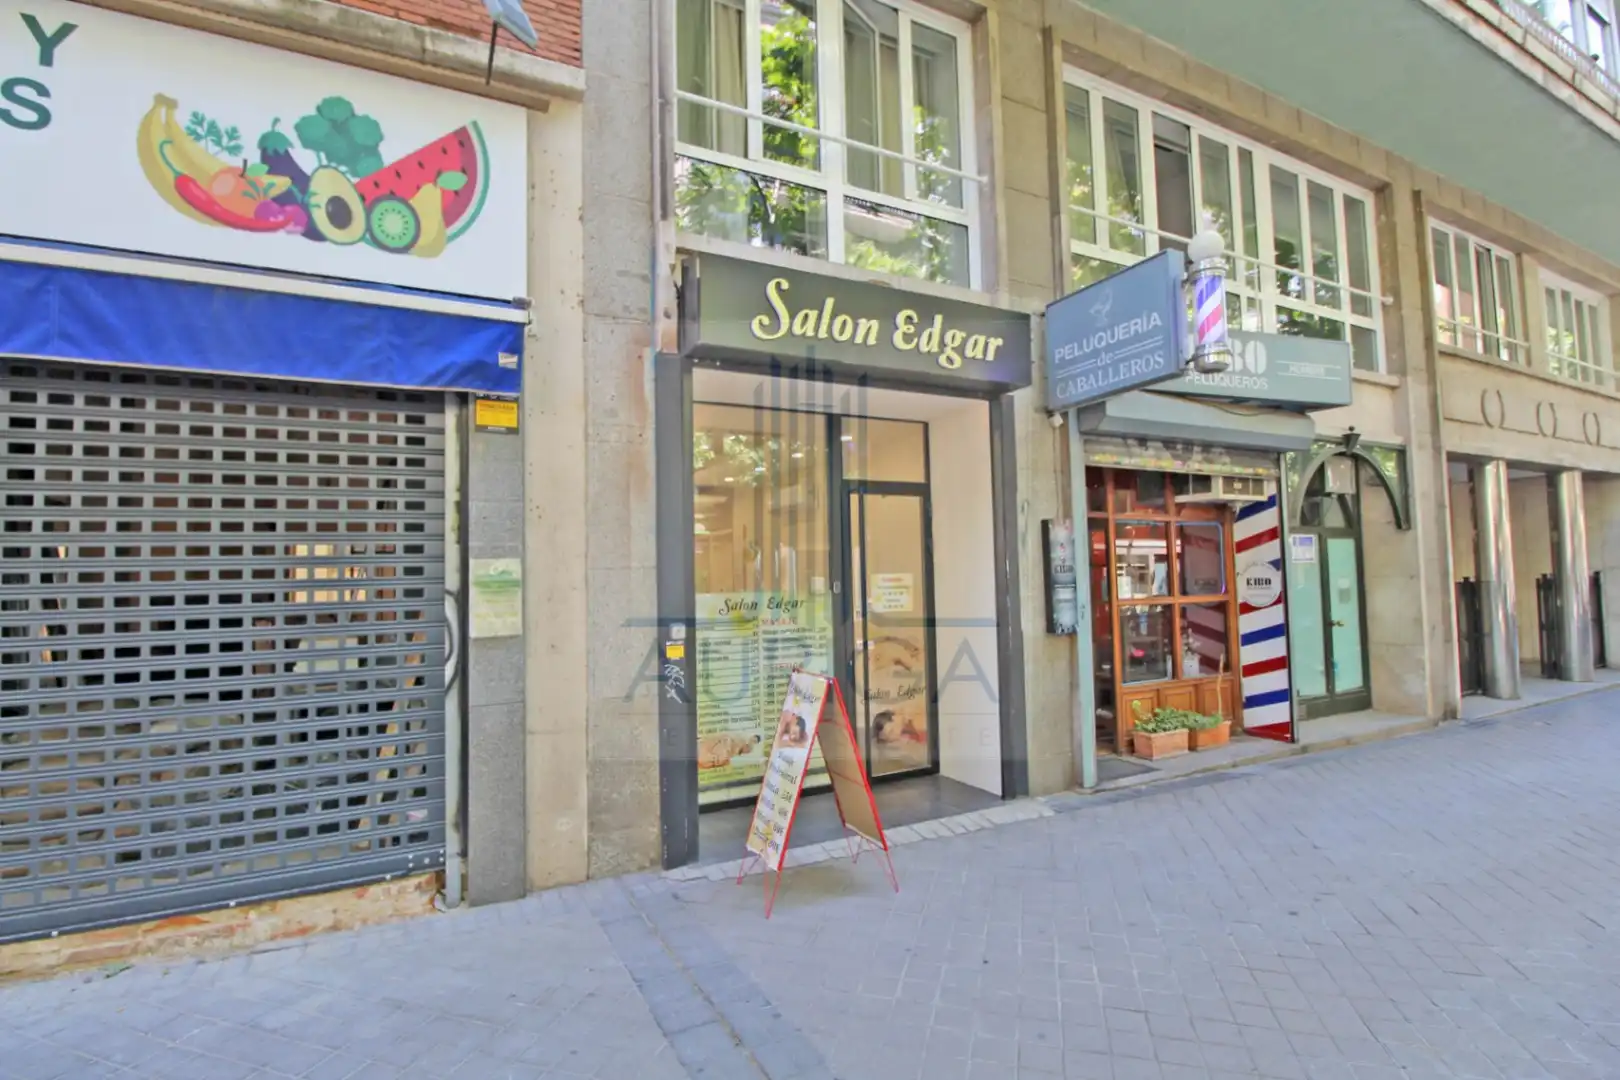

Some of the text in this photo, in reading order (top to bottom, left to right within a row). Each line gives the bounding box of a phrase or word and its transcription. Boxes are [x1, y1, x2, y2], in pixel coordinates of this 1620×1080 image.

[18, 10, 80, 68] Y
[0, 76, 52, 131] S
[750, 277, 1004, 370] Salon Edgar
[1056, 351, 1165, 399] CABALLEROS
[1097, 350, 1115, 366] de
[718, 596, 804, 616] Salon Edgar
